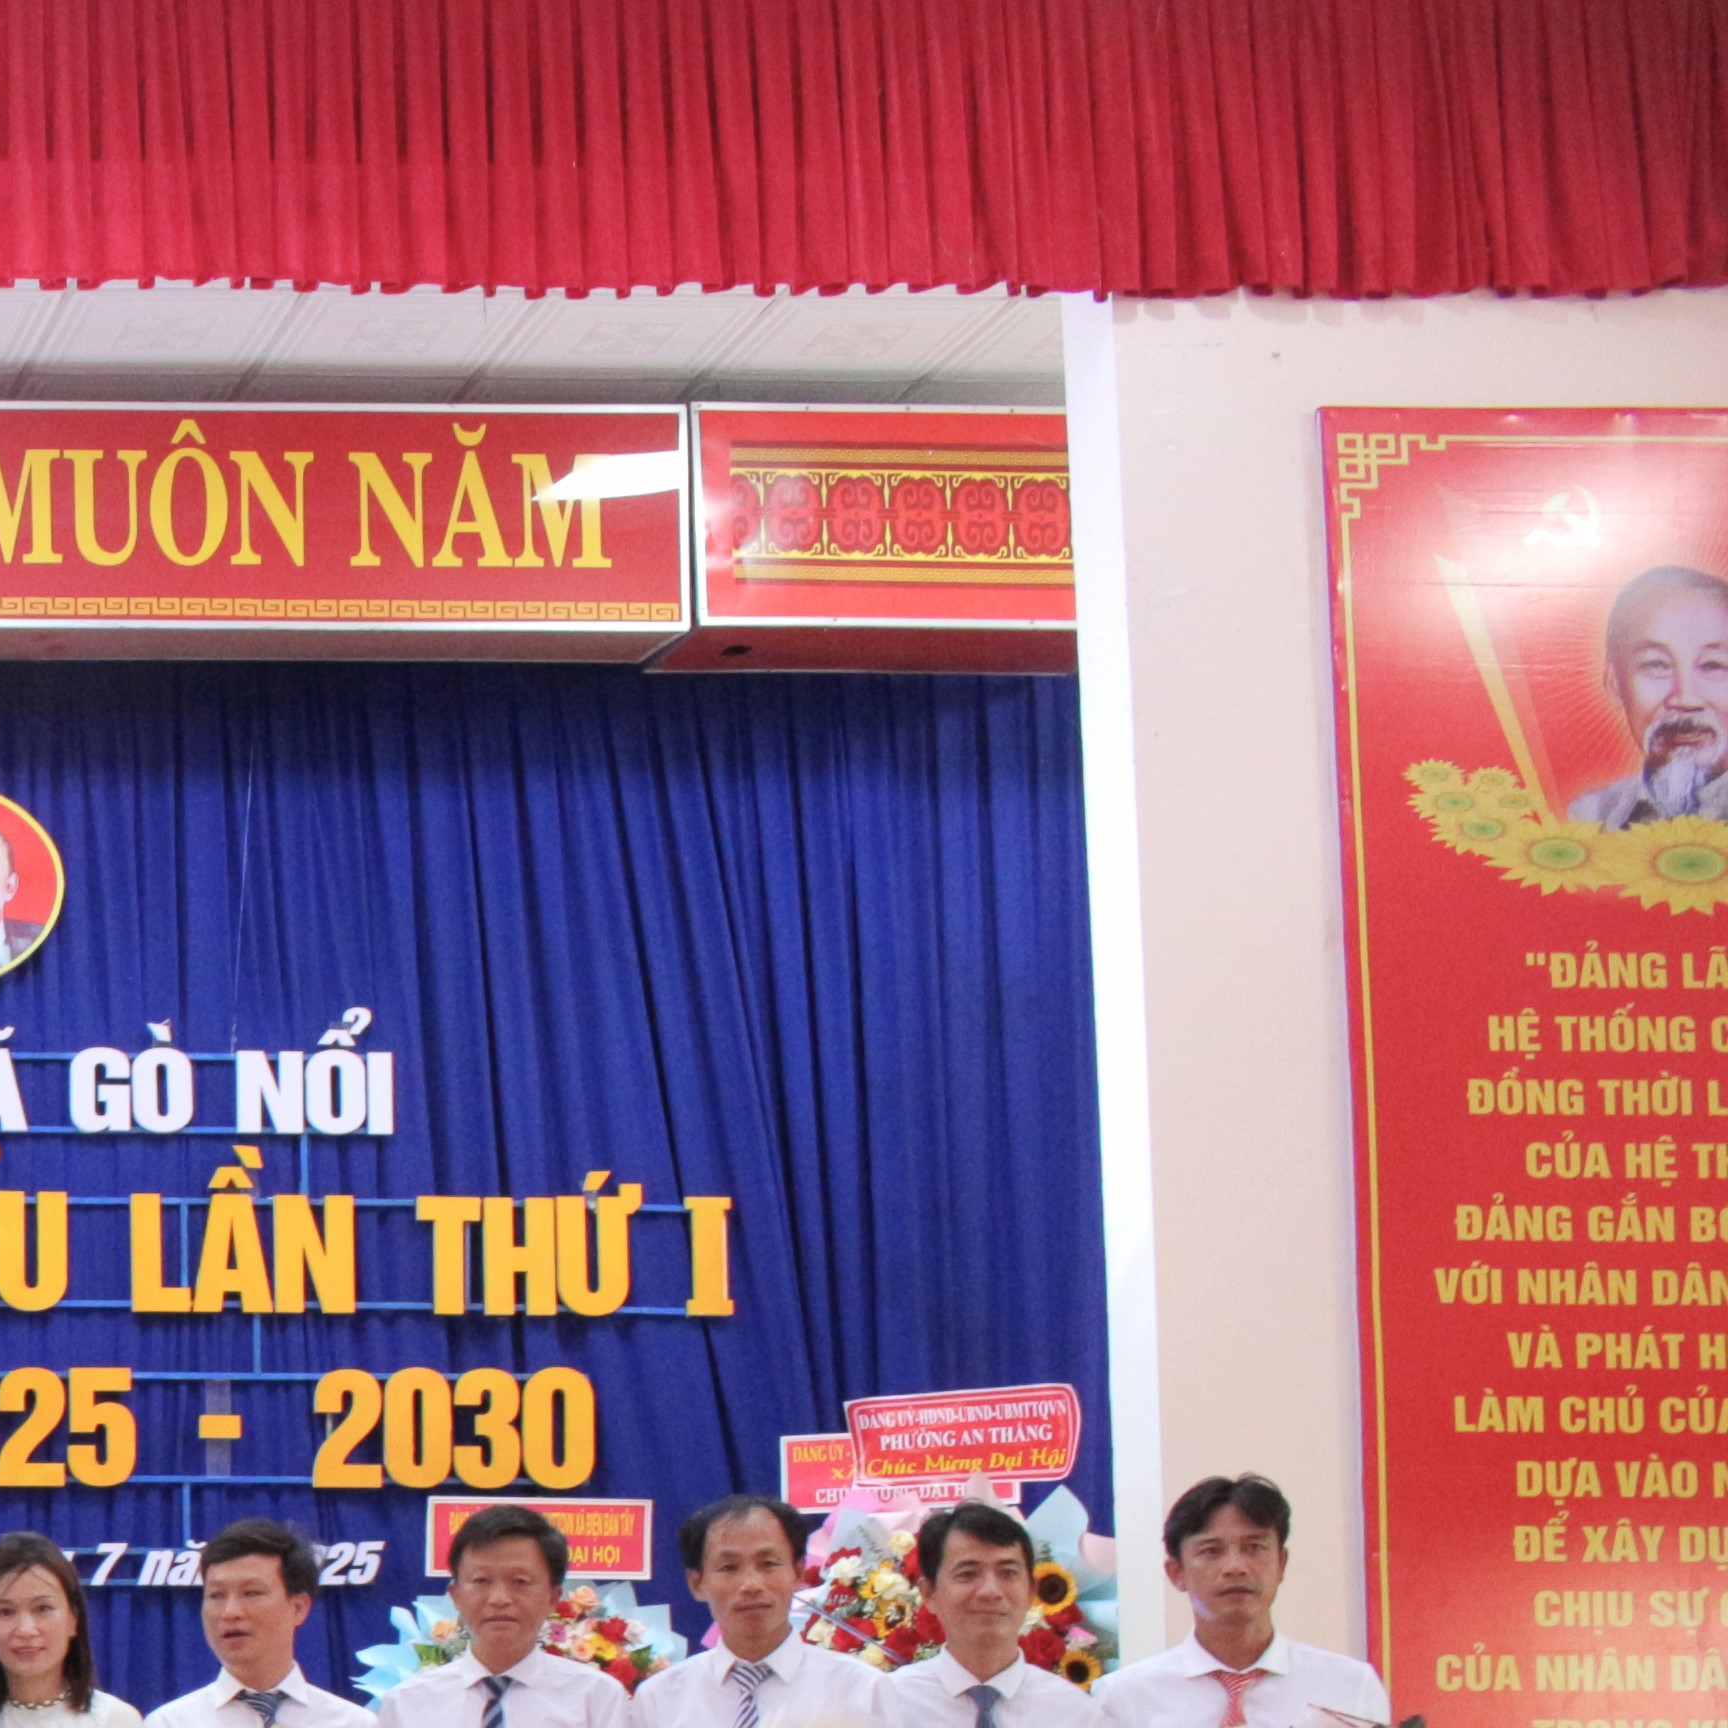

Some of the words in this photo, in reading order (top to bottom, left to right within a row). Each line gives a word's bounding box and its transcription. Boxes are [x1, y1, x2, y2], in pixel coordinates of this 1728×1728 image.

[349, 421, 612, 570] NĂM
[1525, 940, 1668, 989] "ĐẢNG
[1488, 1007, 1542, 1061] HỆ
[1555, 1003, 1697, 1054] THỐNG
[70, 1022, 194, 1133] GÒ
[236, 1006, 394, 1135] NỔI
[1598, 1070, 1693, 1117] THỜI
[1525, 1130, 1612, 1180] CỦA
[1625, 1135, 1678, 1187] HỆ
[131, 1144, 355, 1315] LẦN
[417, 1170, 641, 1317] THỨ
[686, 1196, 735, 1317] I
[1455, 1192, 1573, 1243] ĐẢNG
[1588, 1192, 1676, 1243] GẮN
[1434, 1260, 1503, 1306] VỚI
[1517, 1260, 1638, 1306] NHÂN
[1506, 1324, 1564, 1370] VÀ
[1575, 1324, 1686, 1370] PHÁT
[199, 1414, 240, 1439] -
[314, 1366, 595, 1490] 2030
[1454, 1387, 1544, 1433] LÀM
[1559, 1384, 1645, 1434] CHỦ
[880, 1426, 956, 1451] PHƯỜNG
[960, 1428, 985, 1446] AN
[867, 1457, 916, 1476] Chúc
[1516, 1457, 1604, 1506] DỰA
[1614, 1453, 1699, 1498] VÀO
[90, 1542, 128, 1586] 7
[138, 1538, 205, 1586] nă
[1512, 1510, 1569, 1563] ĐỂ
[1581, 1517, 1665, 1563] XÂY
[1533, 1590, 1635, 1636] CHỊU
[1648, 1586, 1711, 1636] SỰ
[1435, 1641, 1523, 1692] CỦA
[1535, 1646, 1657, 1692] NHÂN
